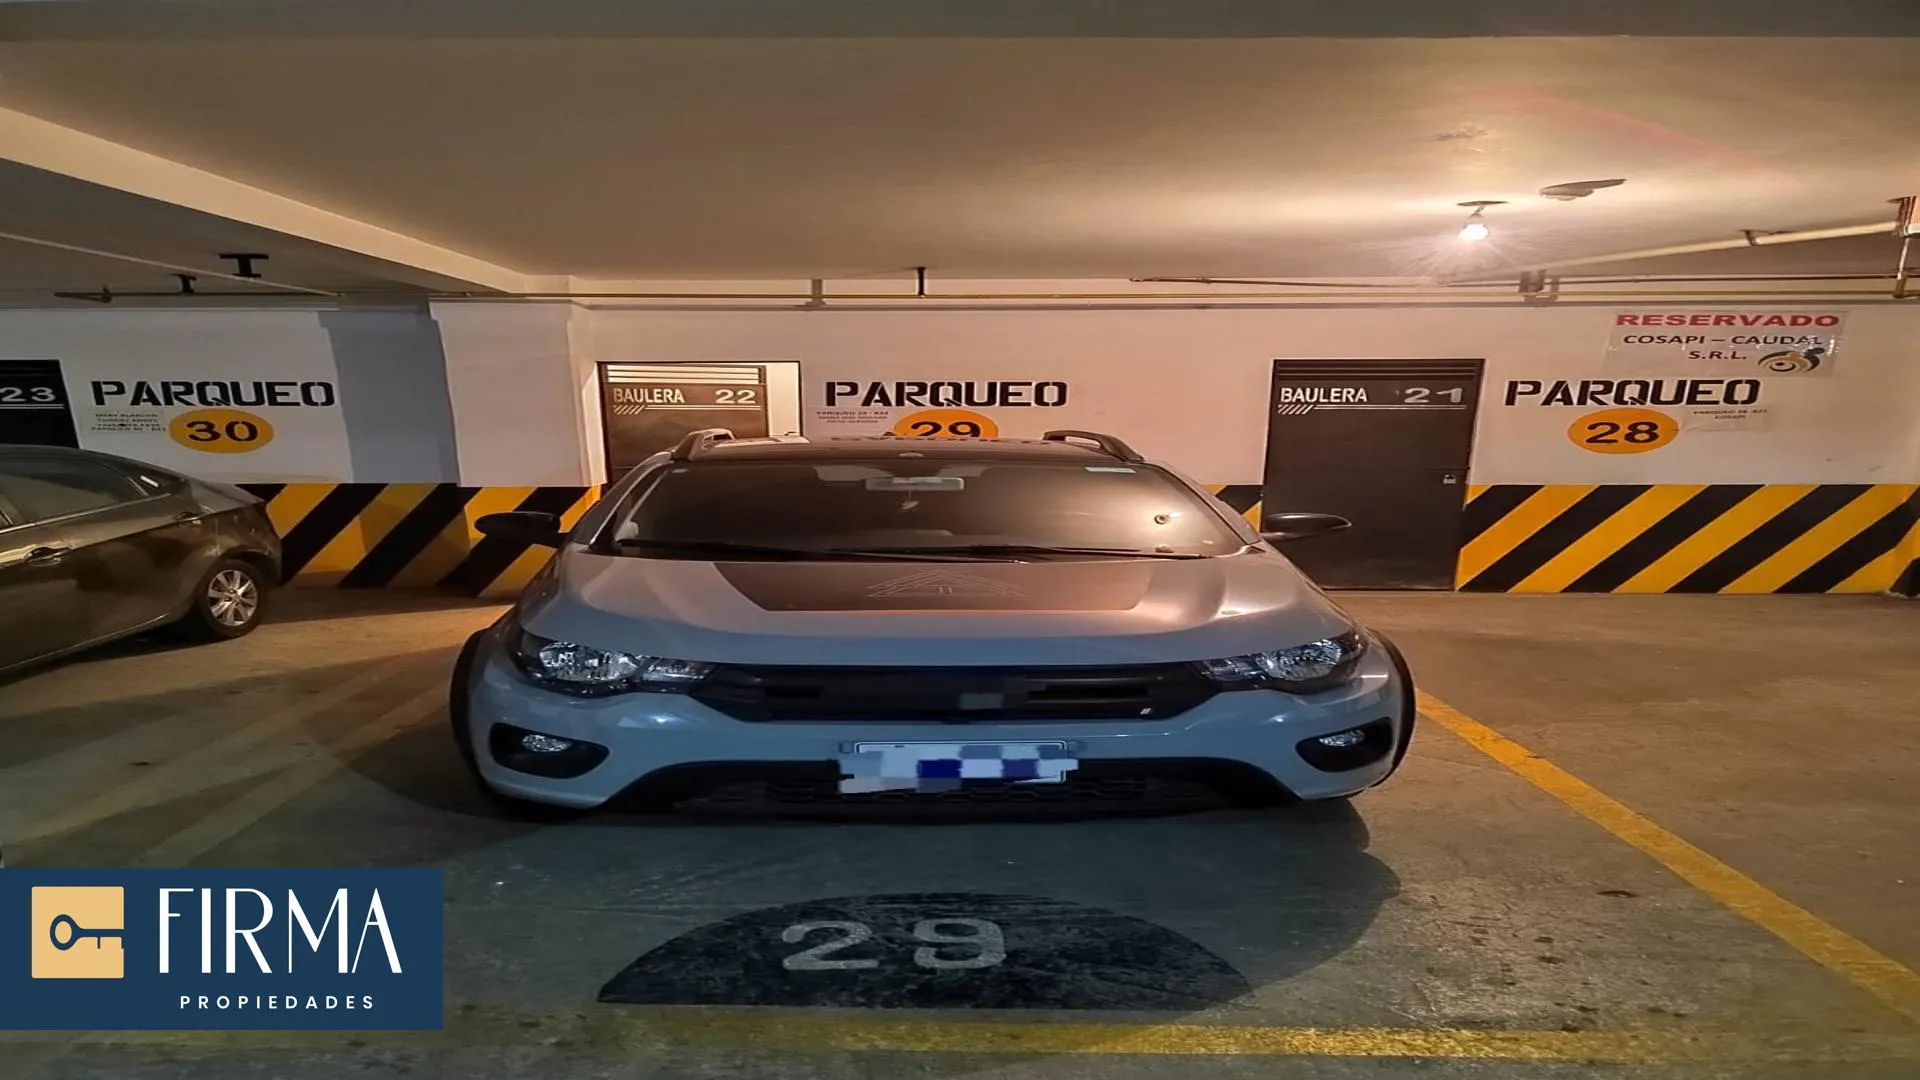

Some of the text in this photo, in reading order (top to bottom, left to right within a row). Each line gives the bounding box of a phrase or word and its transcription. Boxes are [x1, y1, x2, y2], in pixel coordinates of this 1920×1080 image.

[1615, 314, 1840, 327] RESERVADO
[1623, 335, 1705, 345] COSAPI
[1730, 335, 1823, 345] CAUDAL
[1687, 350, 1747, 360] S.R.L.
[0, 387, 56, 402] 23
[91, 380, 336, 407] PARQUEO
[613, 388, 757, 404] BAULERA 22
[826, 381, 1068, 407] PARQUEO
[1279, 387, 1463, 404] BAULERA 21
[1505, 379, 1761, 406] PARQUEO
[186, 420, 259, 442] 30
[911, 421, 982, 437] 29
[1585, 421, 1659, 444] 28
[781, 918, 1007, 970] 29
